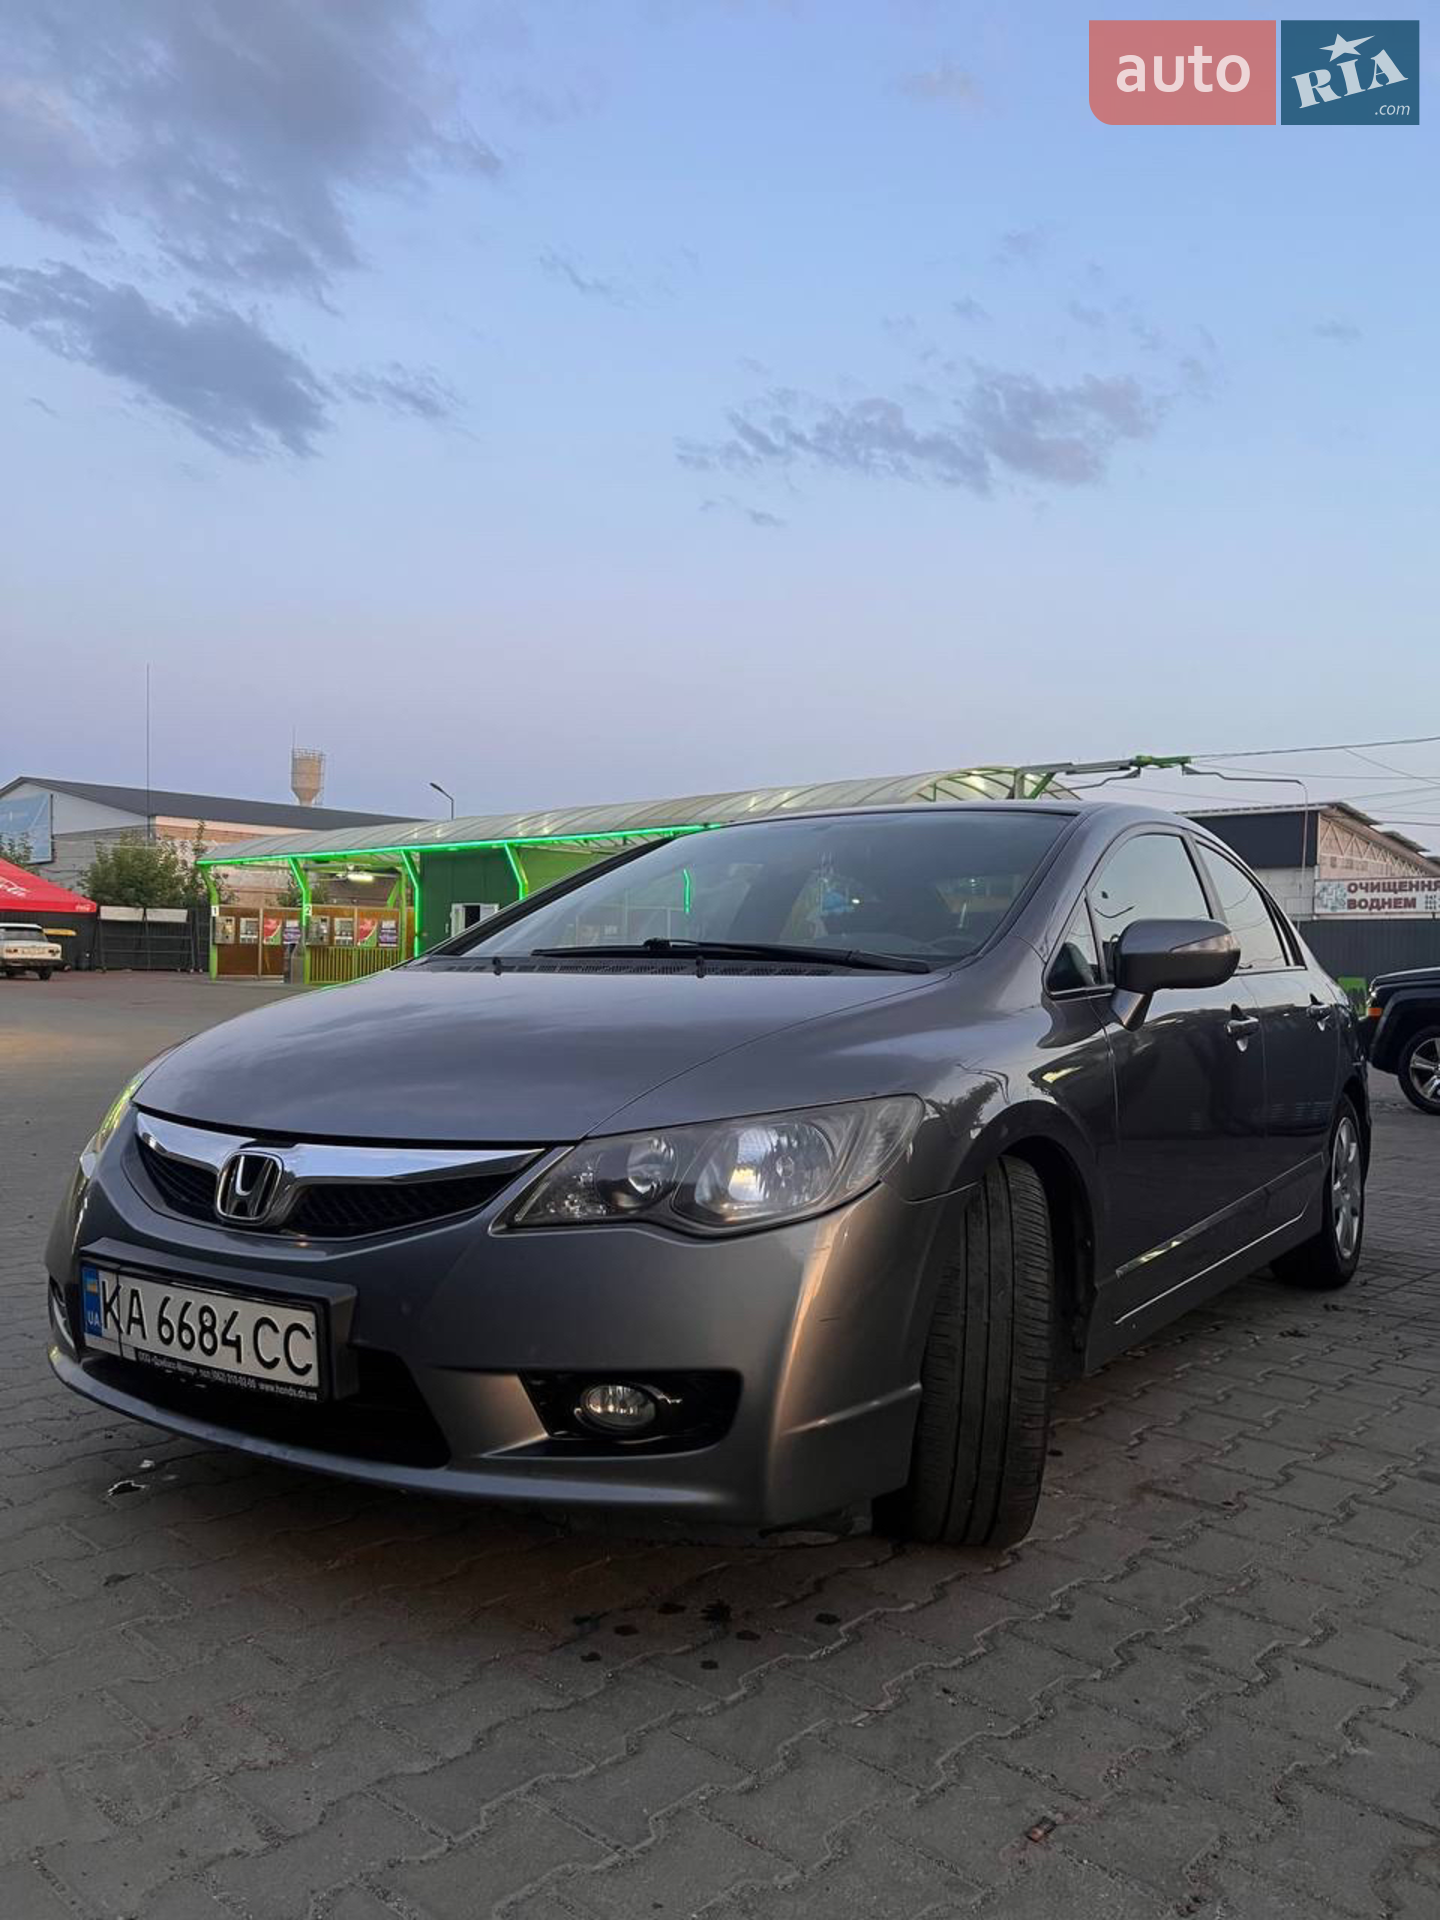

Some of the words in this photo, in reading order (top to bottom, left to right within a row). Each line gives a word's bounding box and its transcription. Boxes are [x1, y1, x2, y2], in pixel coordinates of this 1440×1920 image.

[1346, 897, 1417, 911] ВОДНЕМ
[88, 1311, 100, 1327] UA
[101, 1280, 147, 1340] KA
[157, 1296, 243, 1363] 6684
[252, 1316, 313, 1376] CC
